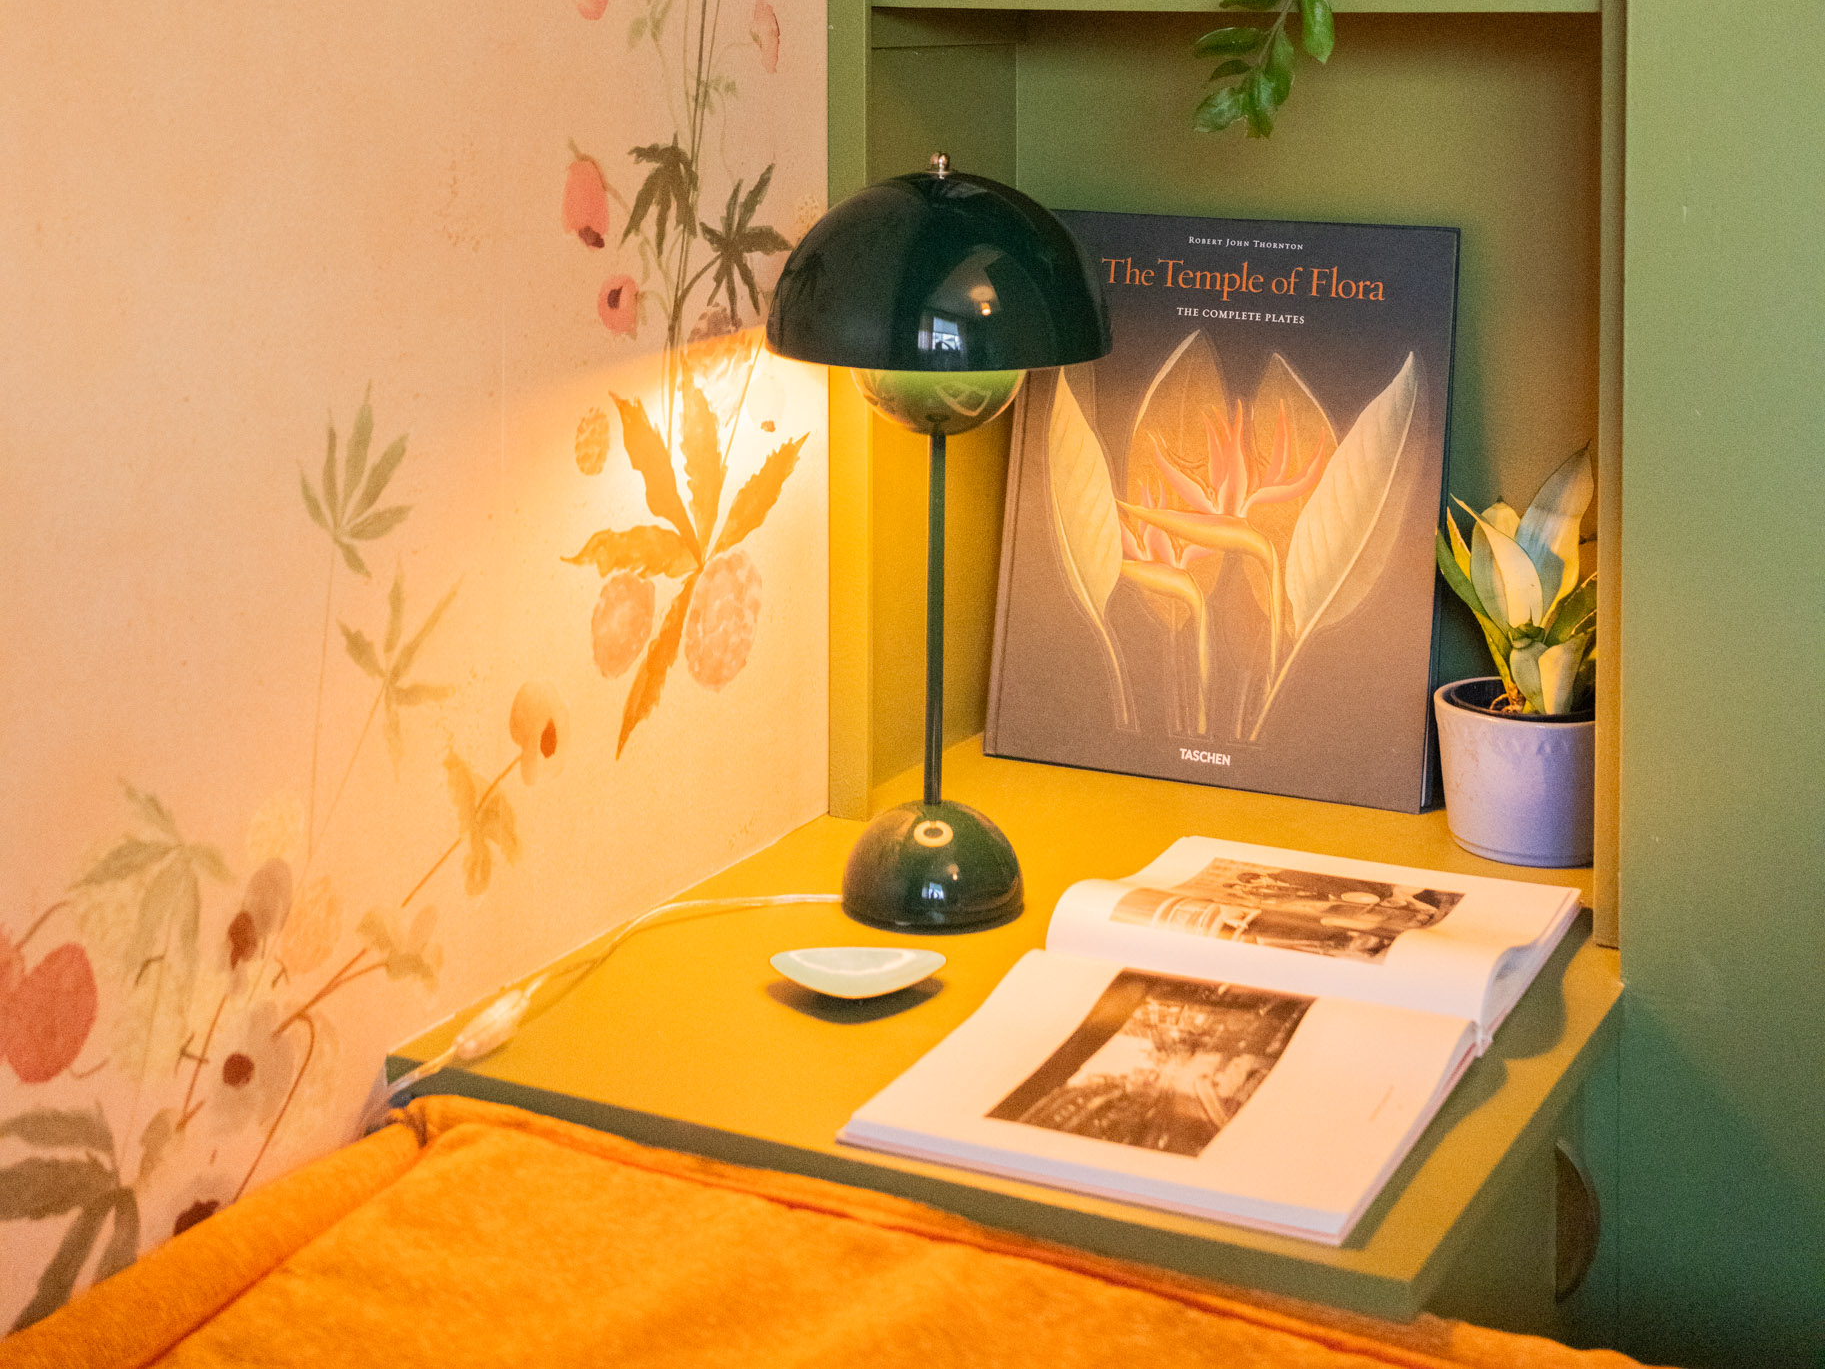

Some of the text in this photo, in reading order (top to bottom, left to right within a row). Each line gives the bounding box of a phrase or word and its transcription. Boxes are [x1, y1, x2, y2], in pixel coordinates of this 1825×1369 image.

[1101, 257, 1386, 302] The Temple of Flora
[1176, 307, 1306, 324] THE COMPLETE PLATES
[1179, 748, 1231, 767] TASCHEN
